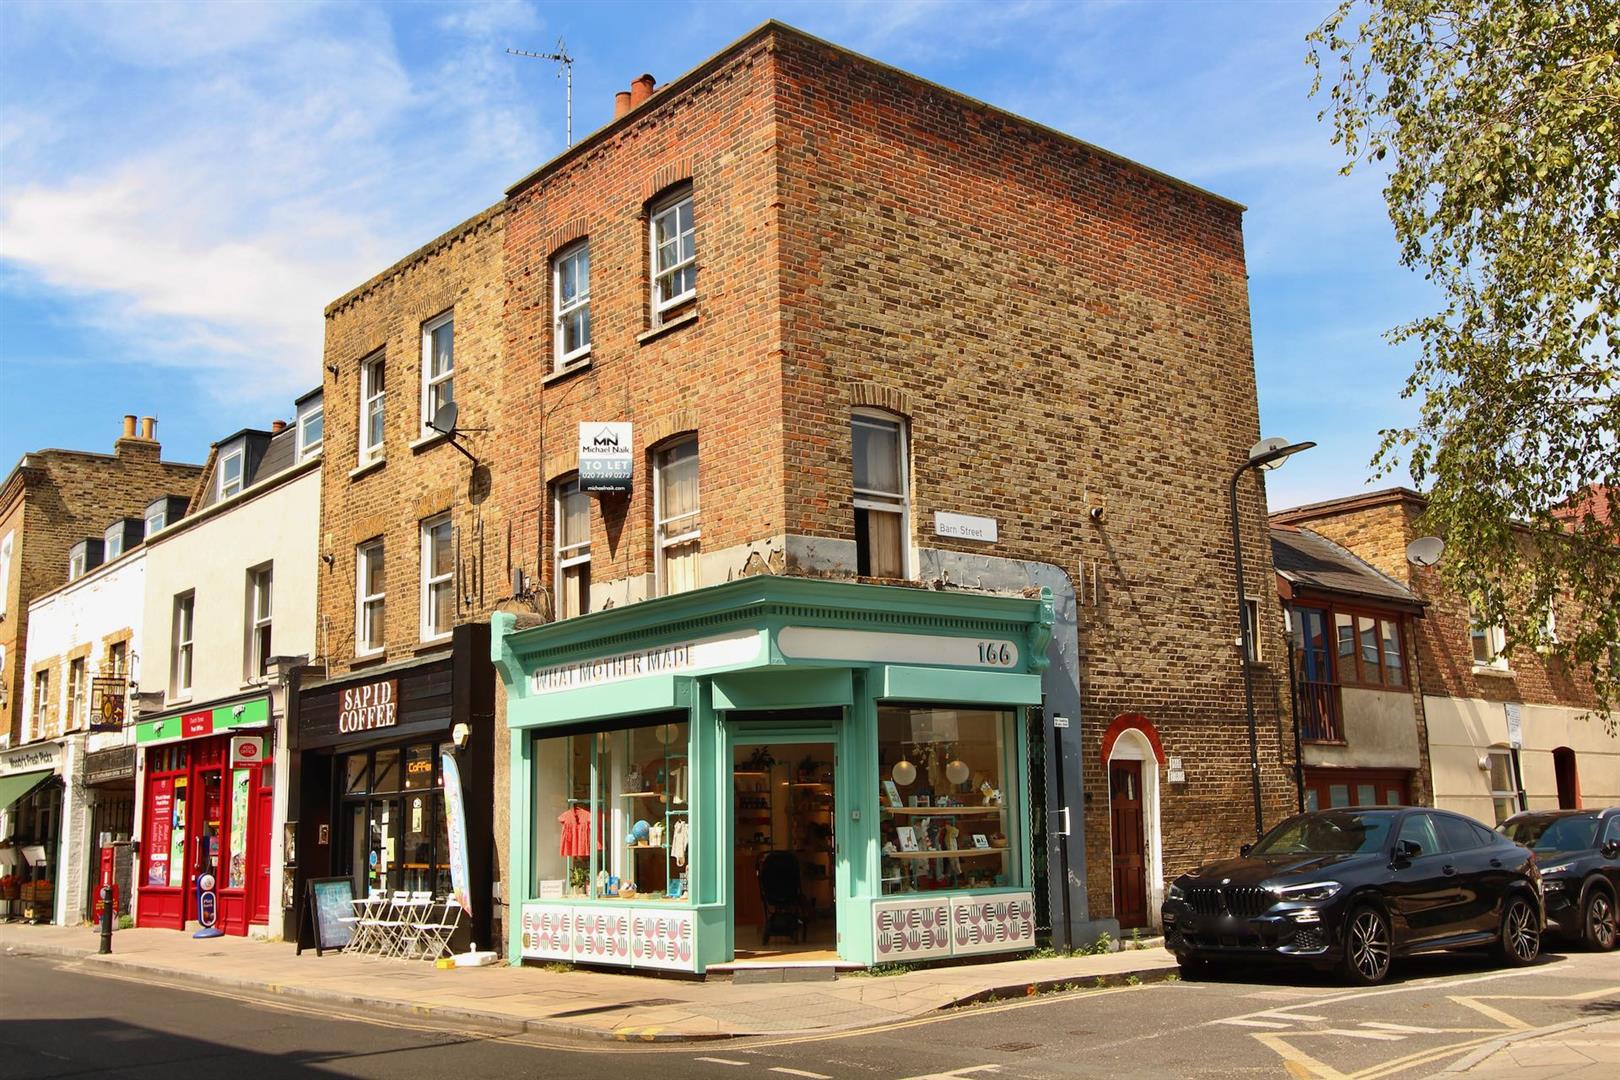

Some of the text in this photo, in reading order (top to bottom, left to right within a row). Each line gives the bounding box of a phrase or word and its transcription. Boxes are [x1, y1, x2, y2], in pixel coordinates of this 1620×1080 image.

[594, 434, 618, 446] MN
[585, 461, 628, 470] TO LET
[939, 523, 984, 538] Barn Street
[977, 642, 1010, 666] 166
[535, 643, 695, 690] WHAT MOTHER MADE
[344, 681, 392, 711] SAPID
[339, 702, 396, 733] COFFEE
